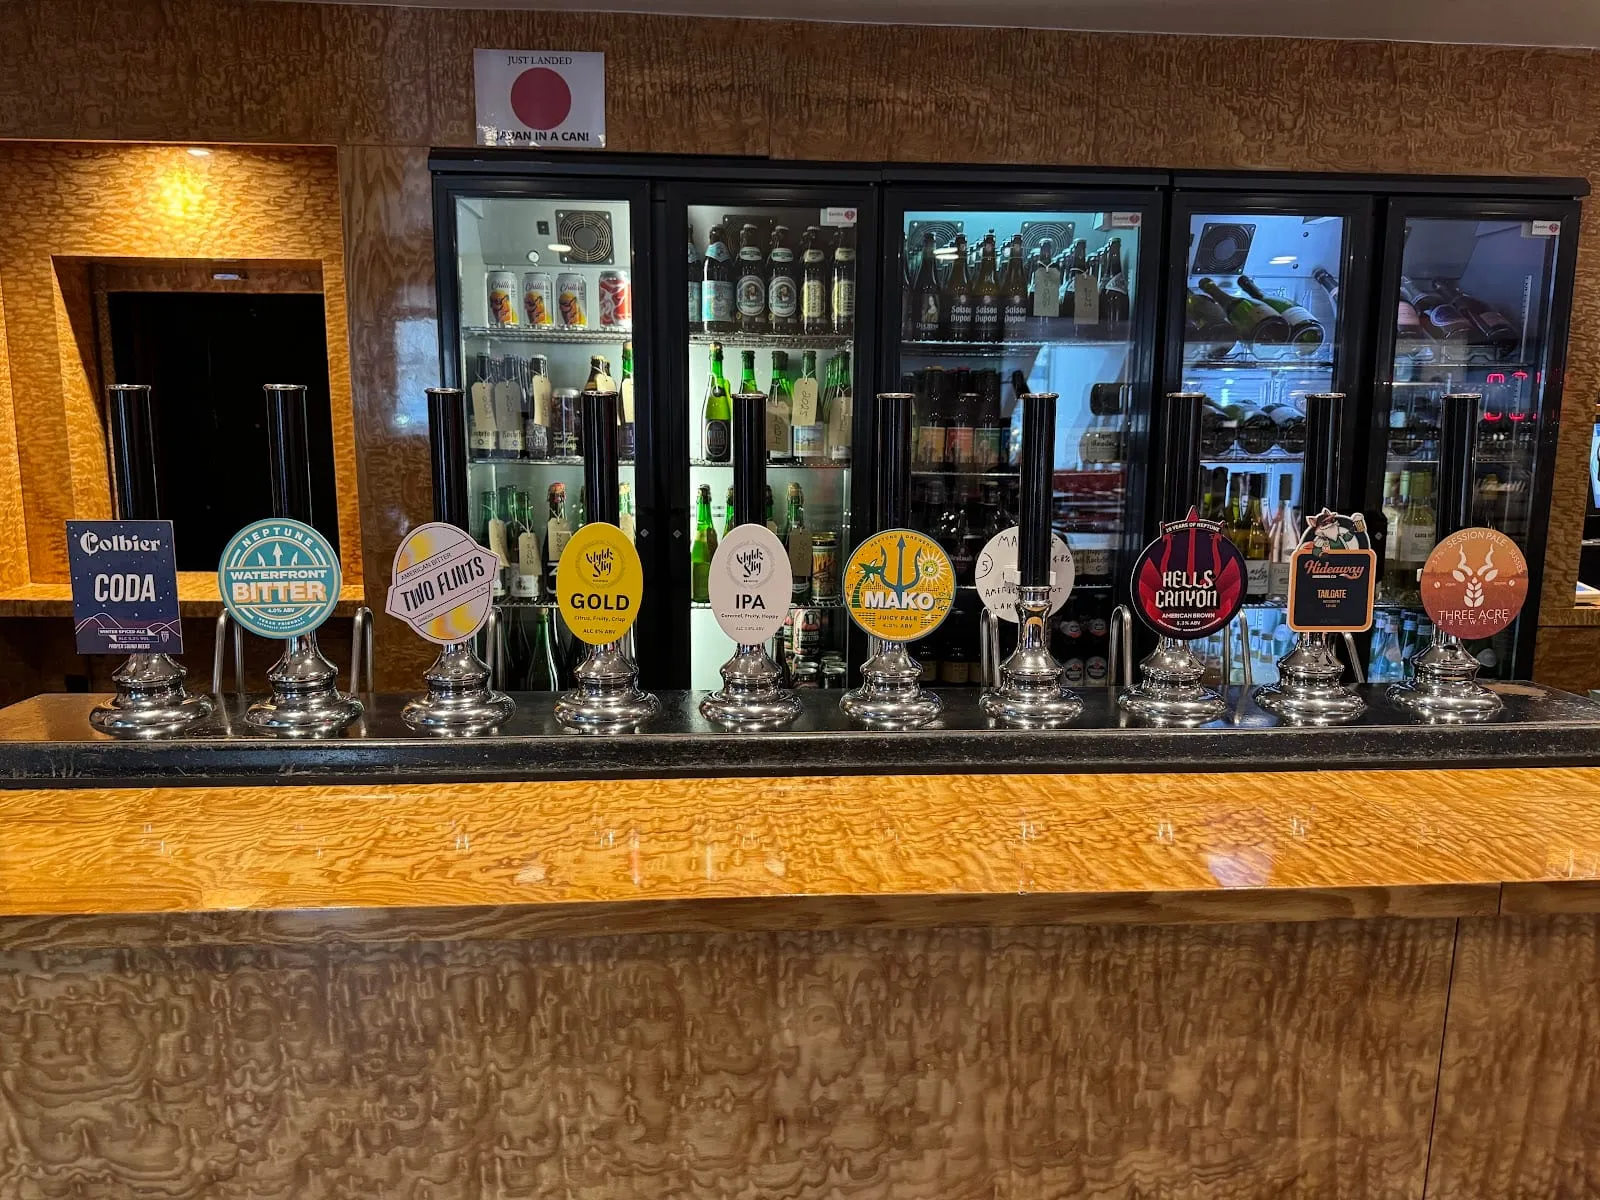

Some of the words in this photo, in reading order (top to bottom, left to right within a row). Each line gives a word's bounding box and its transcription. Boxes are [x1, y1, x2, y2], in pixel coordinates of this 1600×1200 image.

[507, 55, 528, 66] JUST
[530, 56, 573, 65] LANDED
[535, 132, 548, 141] IN
[550, 132, 559, 141] A
[561, 132, 590, 141] CAN!
[1196, 522, 1221, 532] NEPTUNE
[80, 530, 161, 556] Colbier
[242, 527, 314, 548] NEPTUNE
[1446, 531, 1485, 549] SESSION
[1486, 532, 1508, 547] PALE
[230, 570, 328, 580] WATERFRONT
[401, 562, 432, 581] AMERICAN
[433, 552, 452, 566] BITTER
[1304, 560, 1364, 580] Hideaway
[94, 573, 156, 602] CODA
[400, 580, 435, 612] TWO
[436, 556, 485, 596] FLINTS
[1162, 570, 1214, 589] HELLS
[232, 580, 328, 603] BITTER
[864, 590, 936, 610] MAKO
[1317, 589, 1348, 599] TAILGATE
[570, 593, 630, 611] GOLD
[736, 594, 766, 610] IPA
[1438, 609, 1476, 620] THREE
[1478, 608, 1510, 620] ACRE
